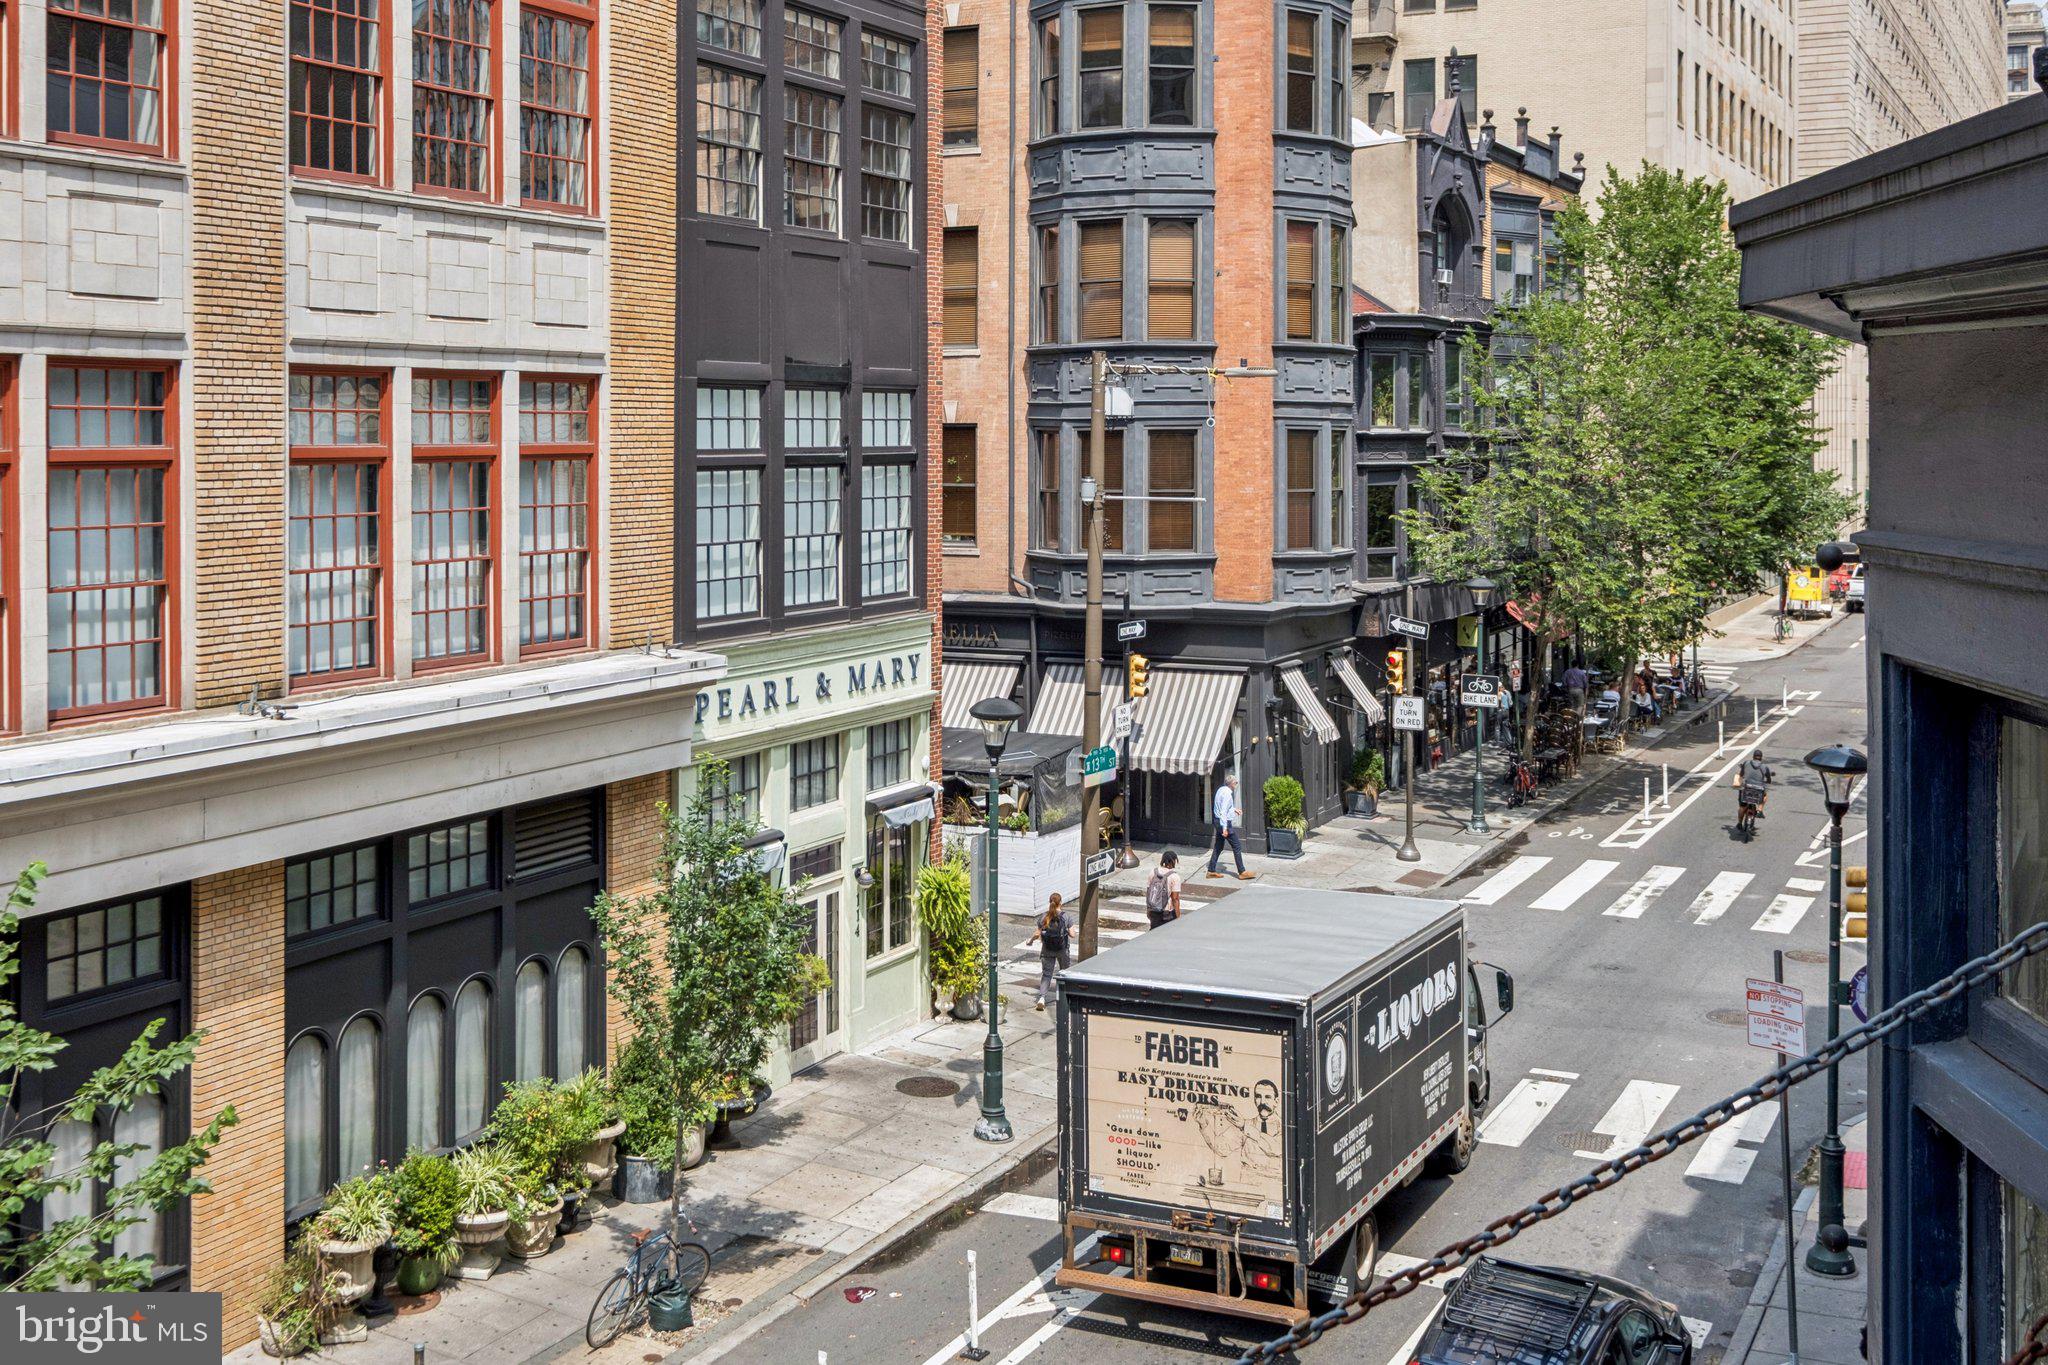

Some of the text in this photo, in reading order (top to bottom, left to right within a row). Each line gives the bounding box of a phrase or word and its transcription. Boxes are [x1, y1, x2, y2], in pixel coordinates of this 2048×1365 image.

[943, 623, 999, 642] ELLA
[1400, 622, 1424, 633] ONE WAY
[695, 653, 921, 724] PEARL & MARY
[1463, 694, 1496, 705] BIKE LANE
[1407, 718, 1420, 726] RED
[1109, 757, 1116, 767] ST
[1377, 961, 1458, 1053] LIQUORS
[1749, 992, 1792, 1008] NO STOPPING
[1754, 1017, 1781, 1029] LOADING
[1784, 1024, 1799, 1034] ONLY
[1145, 1031, 1219, 1068] FABER
[1151, 1068, 1185, 1077] Keystone
[1187, 1073, 1211, 1081] State's
[1117, 1070, 1250, 1099] EASY DRINKING
[1148, 1087, 1219, 1106] LIQUORS
[1136, 1127, 1160, 1138] down
[1126, 1147, 1153, 1159] liquor
